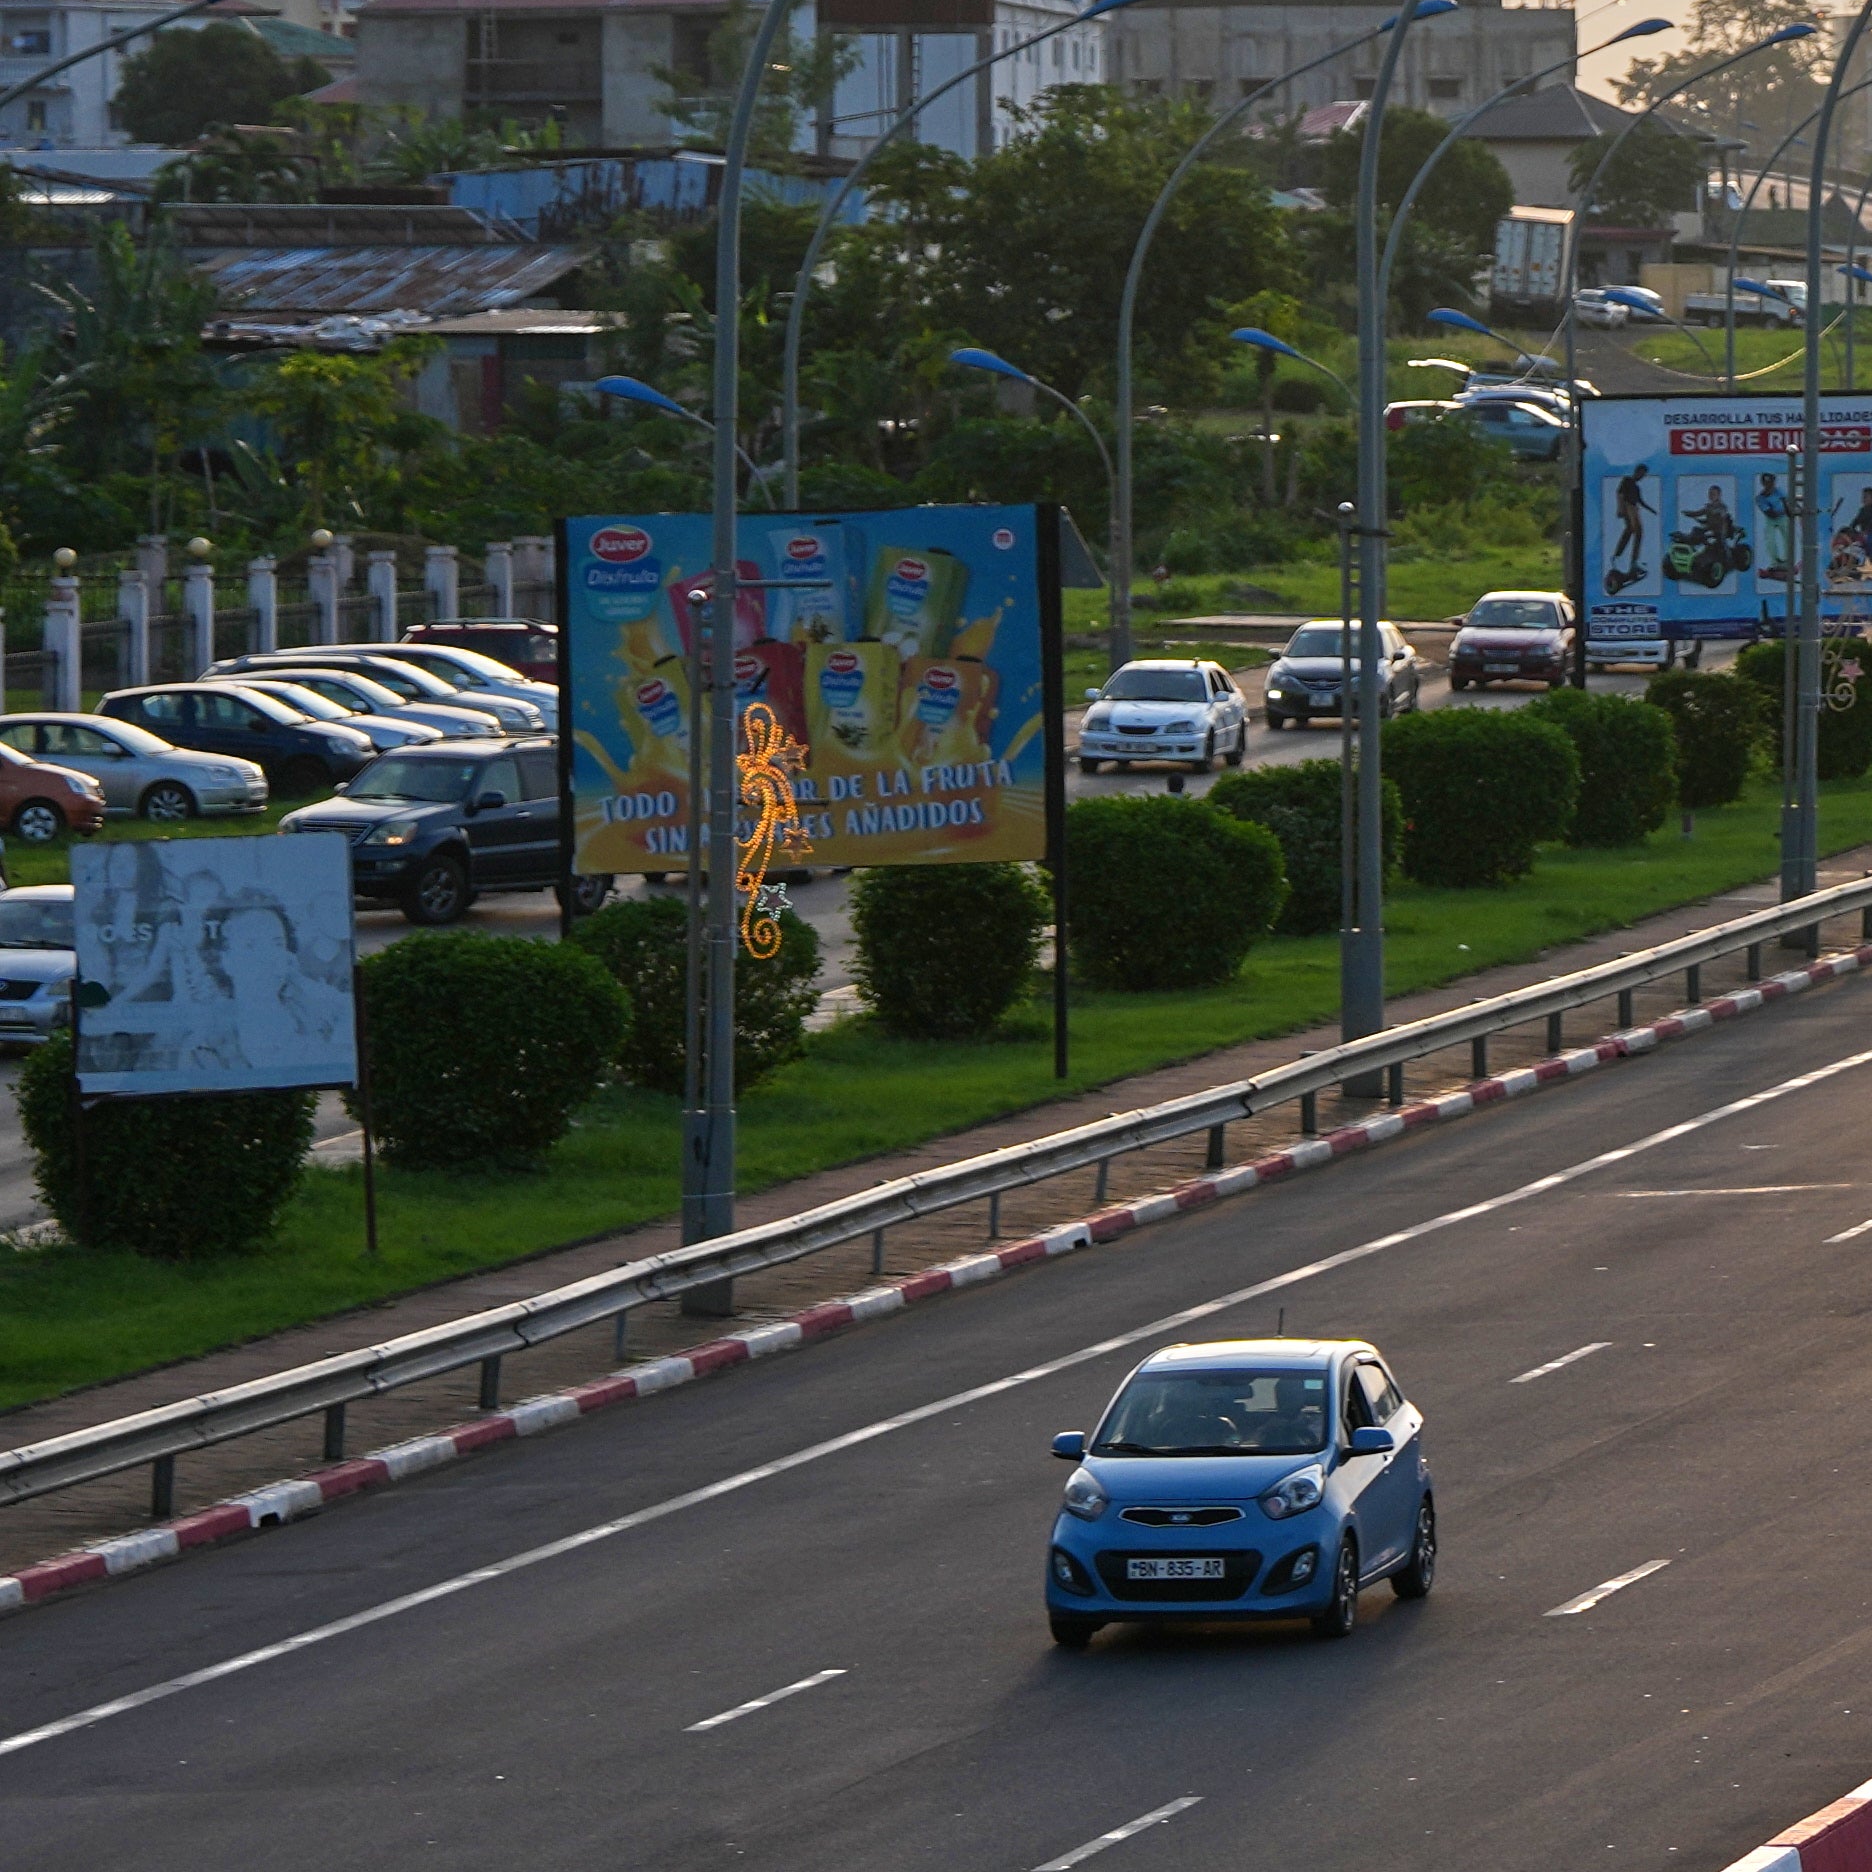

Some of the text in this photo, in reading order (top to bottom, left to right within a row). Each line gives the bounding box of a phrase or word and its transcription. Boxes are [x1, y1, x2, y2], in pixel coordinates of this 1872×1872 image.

[1664, 412, 1753, 425] DESARROLLA
[1756, 412, 1783, 424] TUS
[1681, 431, 1761, 451] SOBRE
[597, 538, 647, 552] Juver
[1591, 624, 1657, 634] STORE
[597, 791, 676, 824] TODO
[828, 774, 864, 801] DE
[876, 769, 910, 797] LA
[921, 759, 1014, 795] FRUTA
[645, 825, 689, 855] SIN
[846, 798, 984, 836] AÑADIDOS
[1139, 1560, 1221, 1577] BN-835-AR
